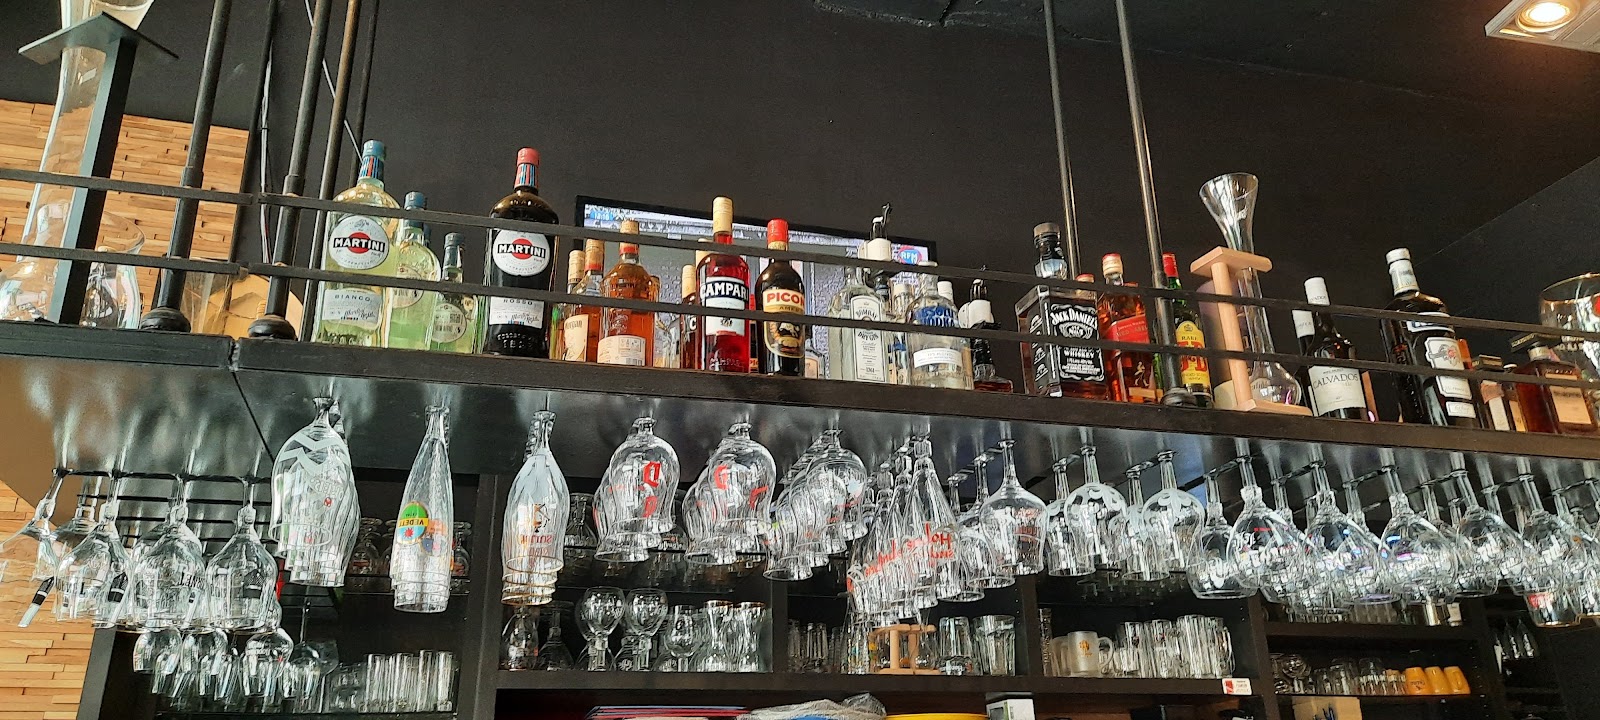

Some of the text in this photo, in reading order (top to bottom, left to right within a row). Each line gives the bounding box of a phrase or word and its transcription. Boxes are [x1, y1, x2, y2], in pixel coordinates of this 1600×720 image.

[334, 238, 385, 252] MARTINI
[498, 244, 546, 258] MARTINI
[901, 251, 918, 264] RFM
[334, 294, 371, 302] BIANCO
[700, 282, 749, 301] CAMPARI
[1050, 310, 1069, 325] JACK
[1312, 373, 1358, 389] CALVADOS
